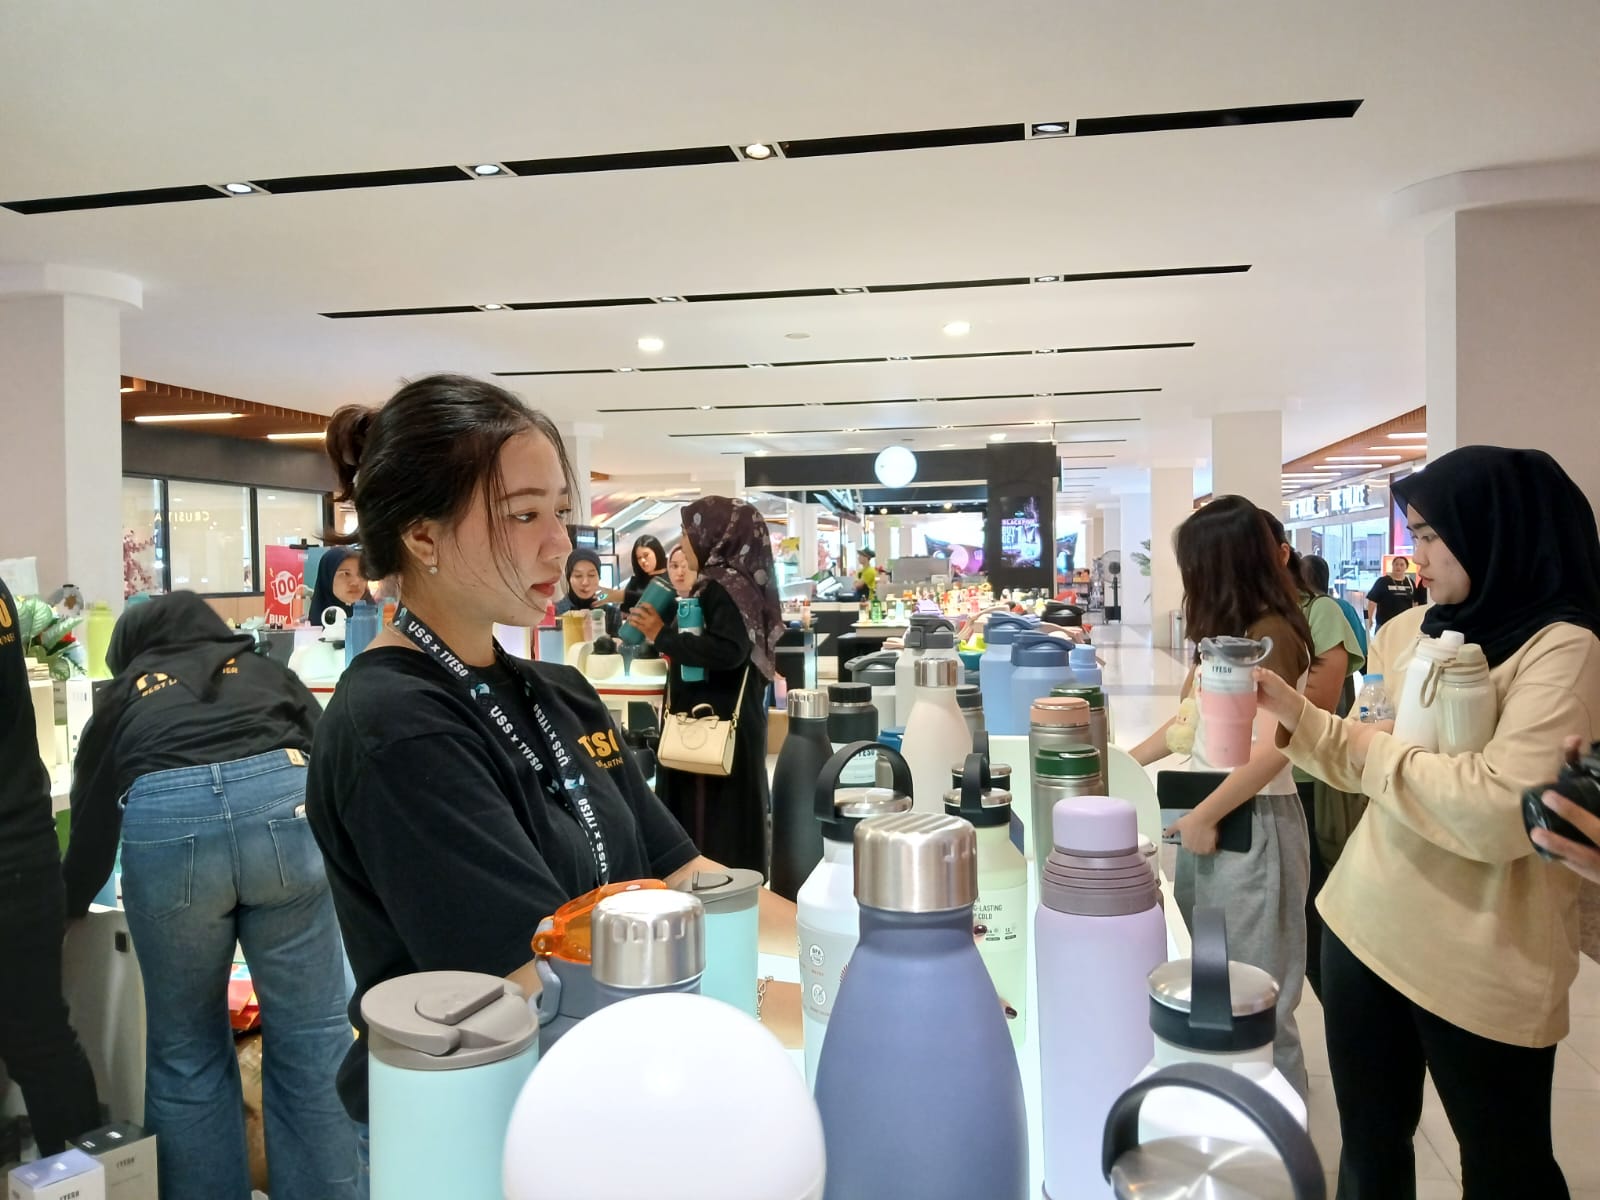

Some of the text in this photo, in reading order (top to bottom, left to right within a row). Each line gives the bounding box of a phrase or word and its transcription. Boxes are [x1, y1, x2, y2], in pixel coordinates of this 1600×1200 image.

[272, 577, 297, 598] 100
[269, 614, 288, 626] BUY
[408, 621, 432, 644] USS
[439, 650, 469, 677] TYESO
[533, 703, 551, 733] TYESO
[490, 705, 514, 734] USS
[518, 742, 543, 771] TYESO
[552, 740, 569, 767] USS
[578, 798, 598, 829] TYESO
[596, 842, 607, 873] USS
